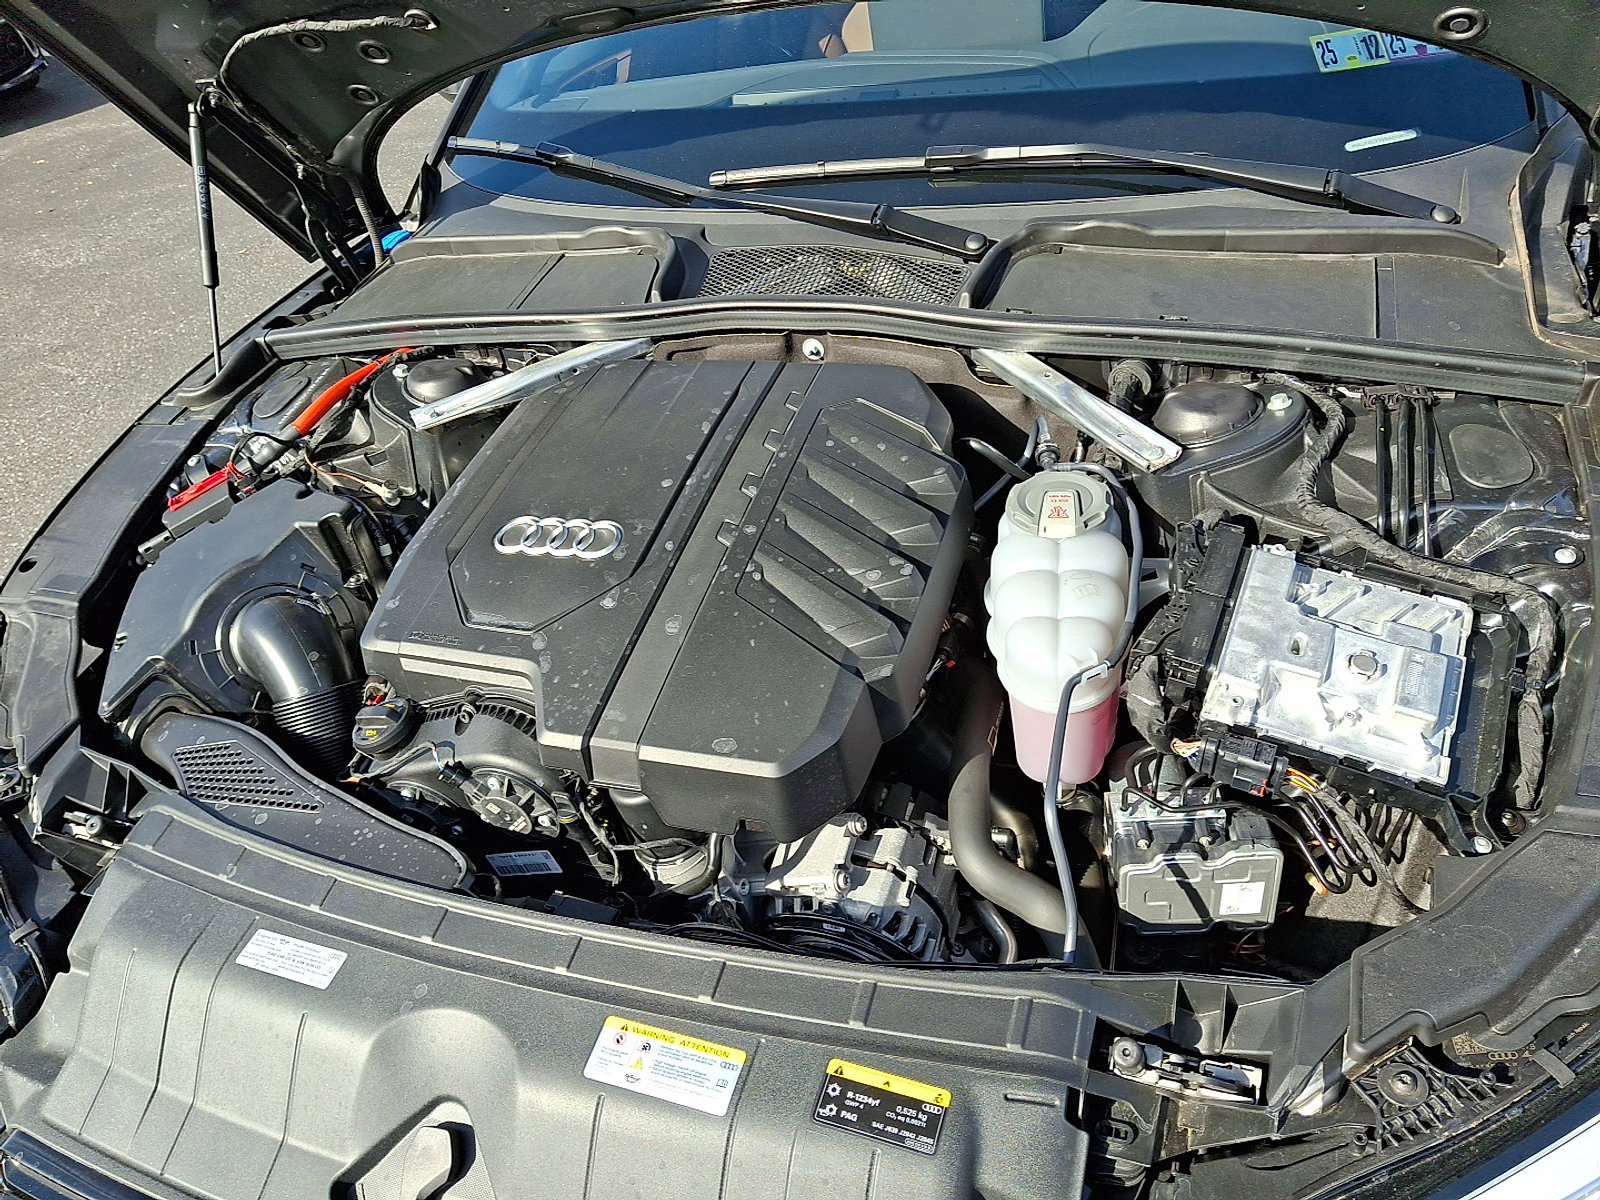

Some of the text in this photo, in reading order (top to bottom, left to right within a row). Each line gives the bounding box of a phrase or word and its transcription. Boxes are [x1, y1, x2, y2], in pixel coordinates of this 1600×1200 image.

[1315, 39, 1339, 68] 25
[1360, 34, 1385, 60] 12
[1385, 33, 1407, 55] 25
[632, 1026, 676, 1044] WARNING
[679, 1040, 731, 1058] ATTENTION
[846, 1091, 880, 1107] R-1234yf
[840, 1110, 858, 1122] PAG
[918, 1111, 928, 1122] kg
